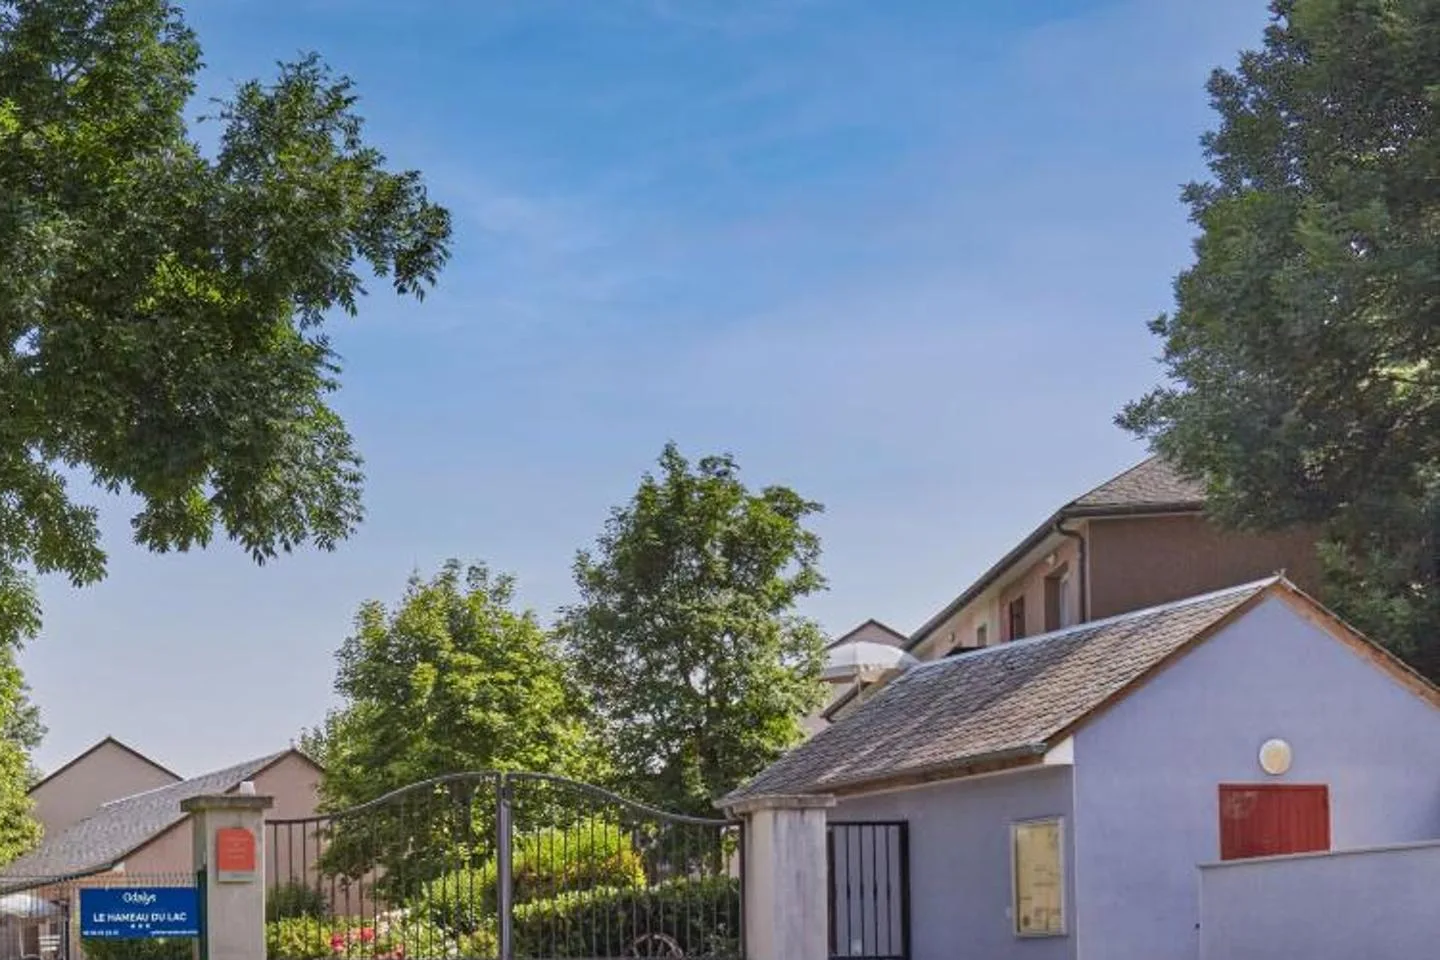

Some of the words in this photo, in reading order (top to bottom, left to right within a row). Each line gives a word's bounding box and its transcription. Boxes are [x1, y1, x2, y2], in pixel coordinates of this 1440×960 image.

[122, 891, 157, 906] Odalys
[93, 912, 105, 922] LE
[107, 912, 149, 922] HAMEAU
[151, 911, 166, 922] DU
[167, 911, 187, 922] LAC
